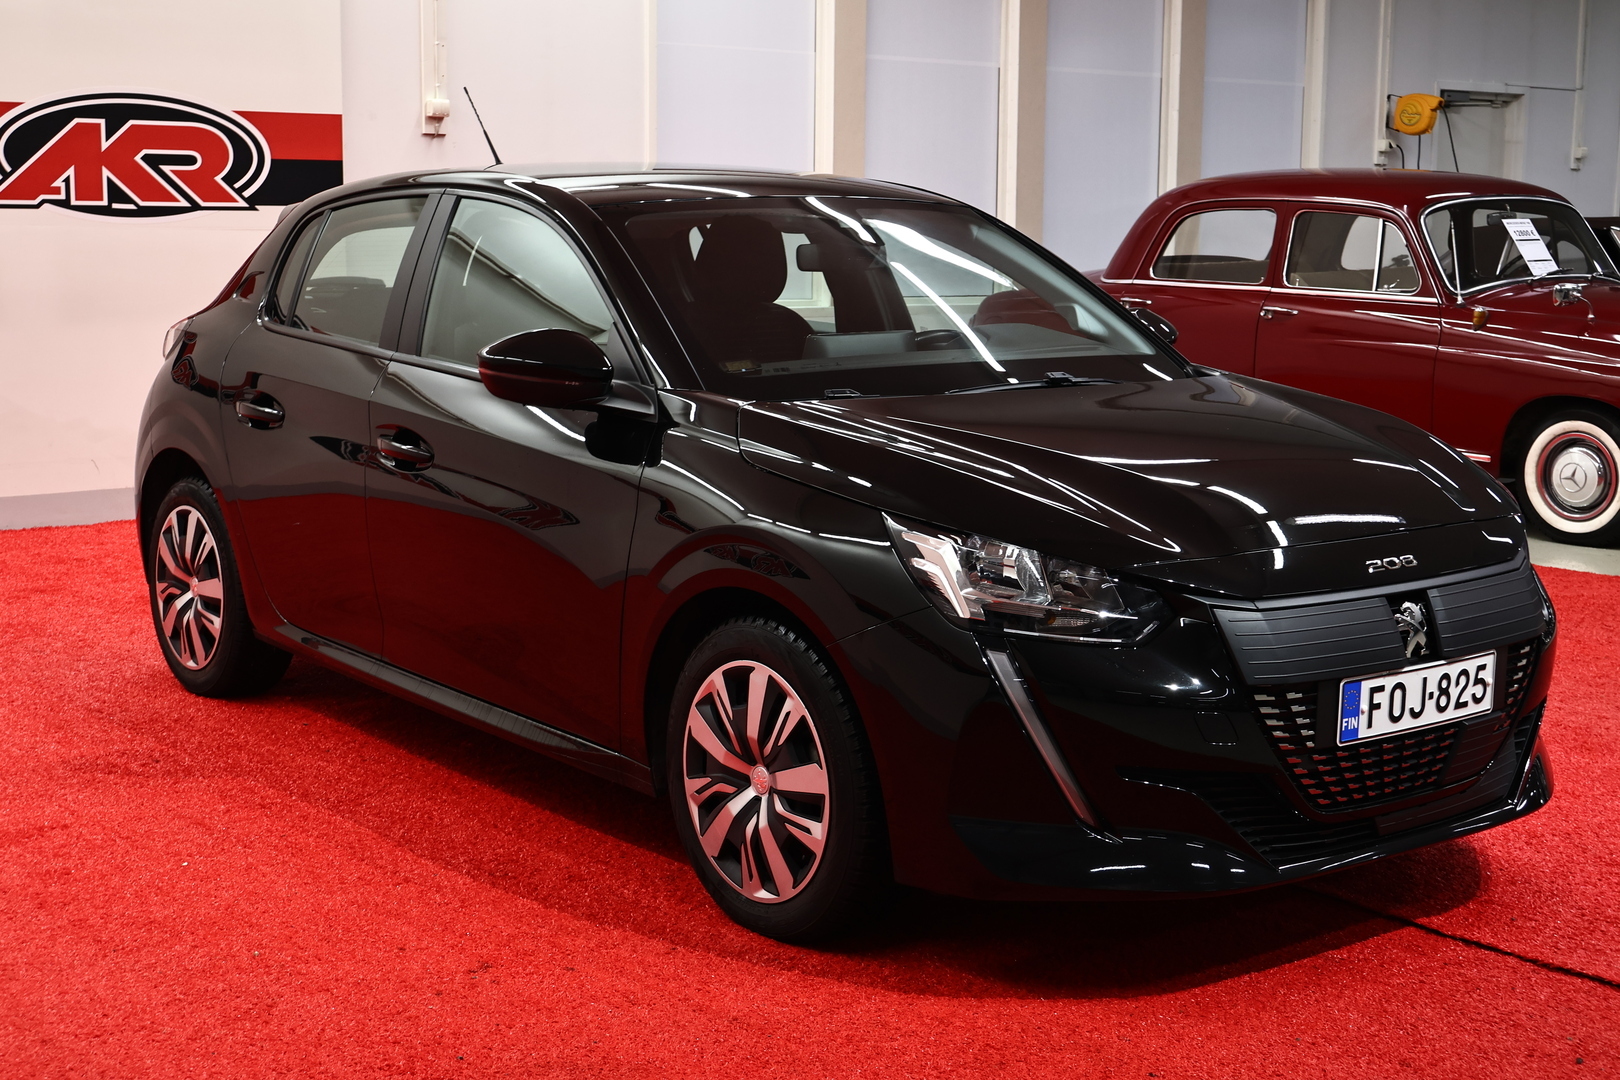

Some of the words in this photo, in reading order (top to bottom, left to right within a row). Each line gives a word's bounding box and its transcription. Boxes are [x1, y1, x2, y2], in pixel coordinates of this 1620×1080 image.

[0, 117, 251, 207] AKR
[1365, 554, 1418, 573] 208
[1367, 664, 1487, 729] FOJ-825
[1342, 716, 1358, 732] FIN
